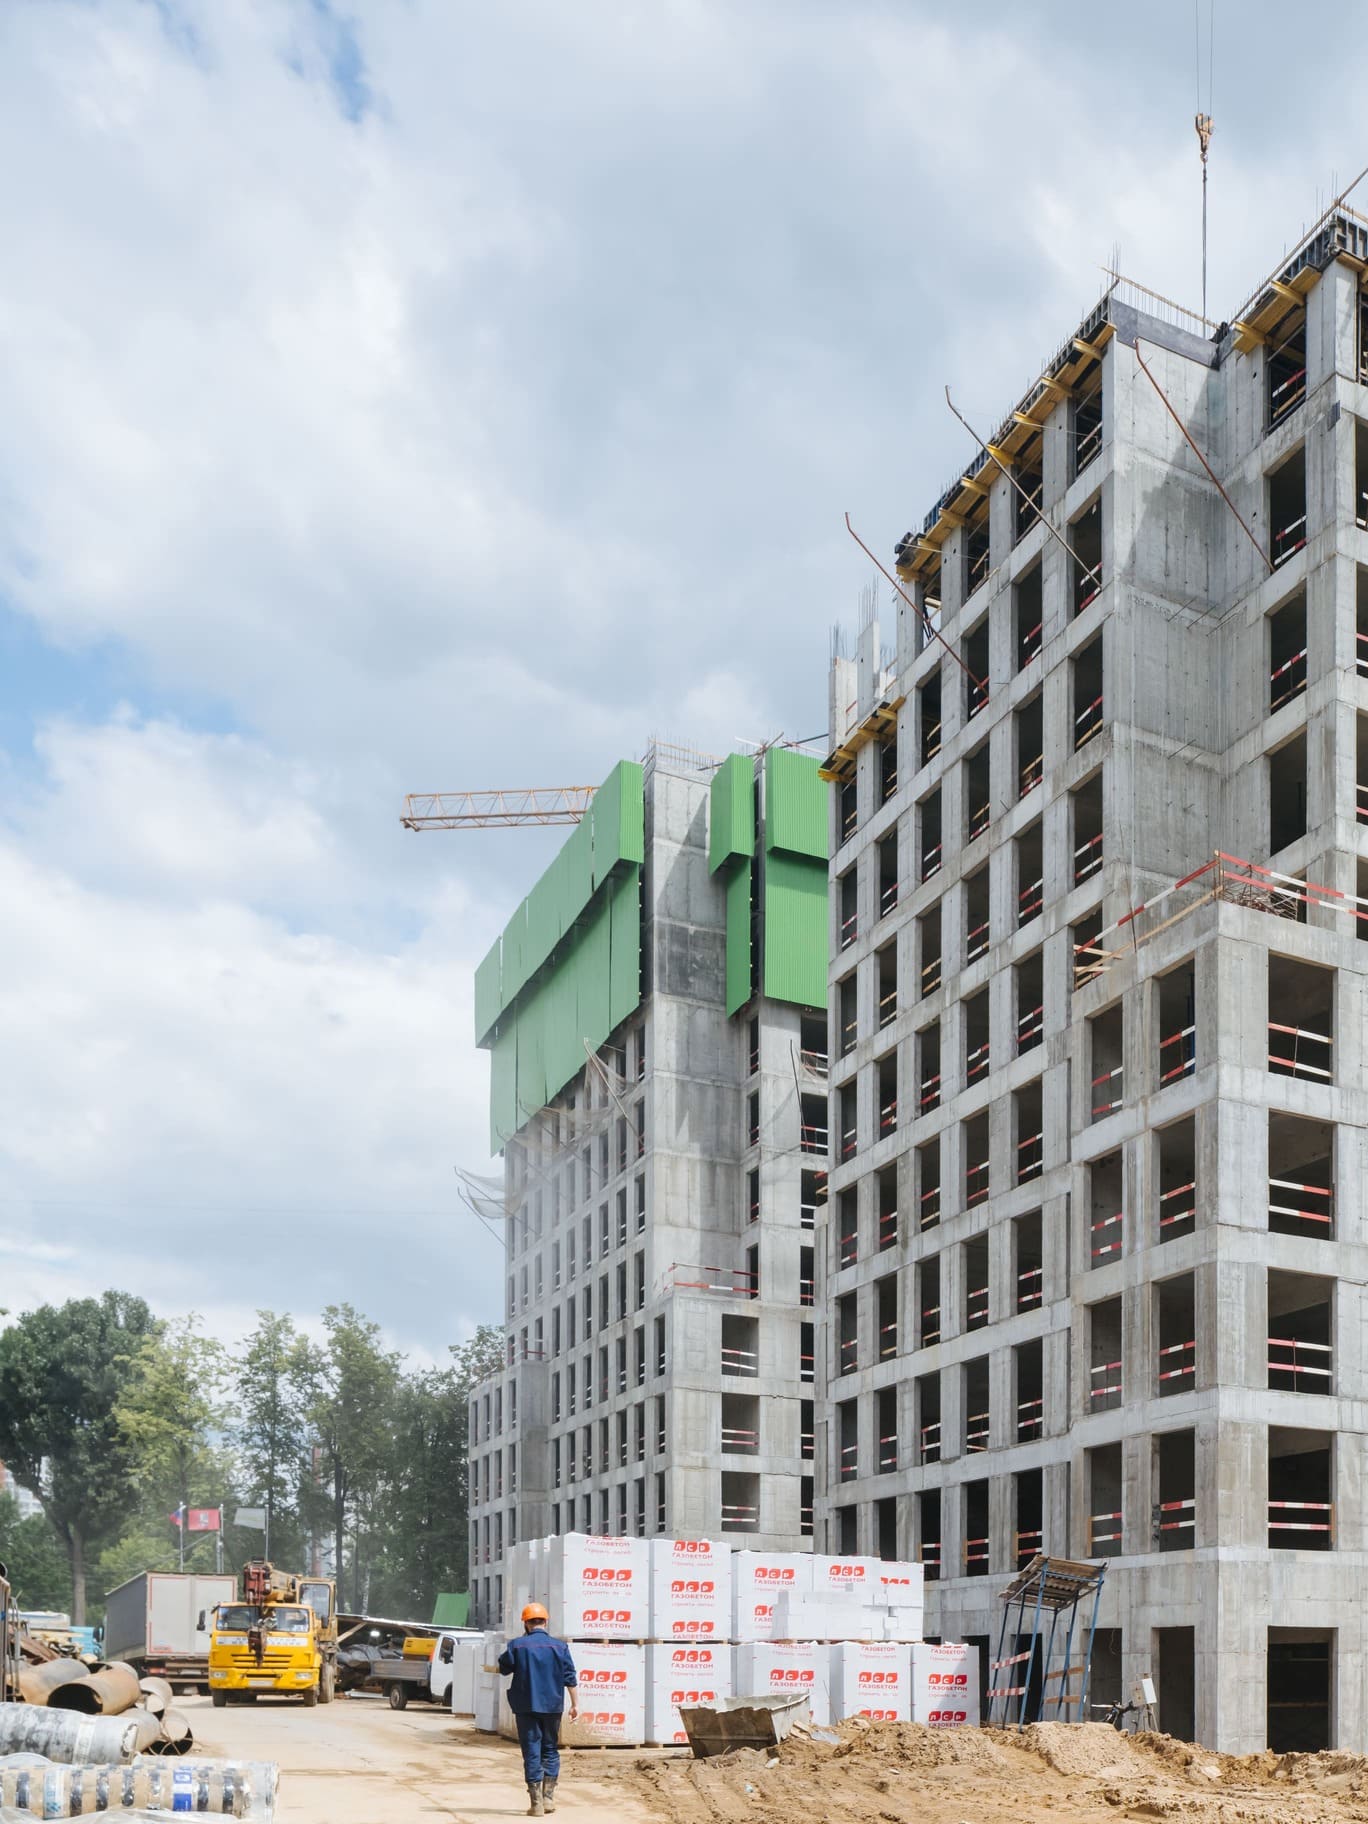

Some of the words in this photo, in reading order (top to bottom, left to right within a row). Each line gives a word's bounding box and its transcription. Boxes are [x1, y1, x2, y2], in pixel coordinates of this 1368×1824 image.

[583, 1569, 632, 1580] ЛСР
[671, 1581, 714, 1592] ЛСР
[672, 1651, 712, 1661] ЛСР
[579, 1670, 627, 1682] ЛСР
[770, 1670, 814, 1680] ЛСР
[859, 1672, 897, 1682] ЛСР
[929, 1674, 967, 1684] ЛСР
